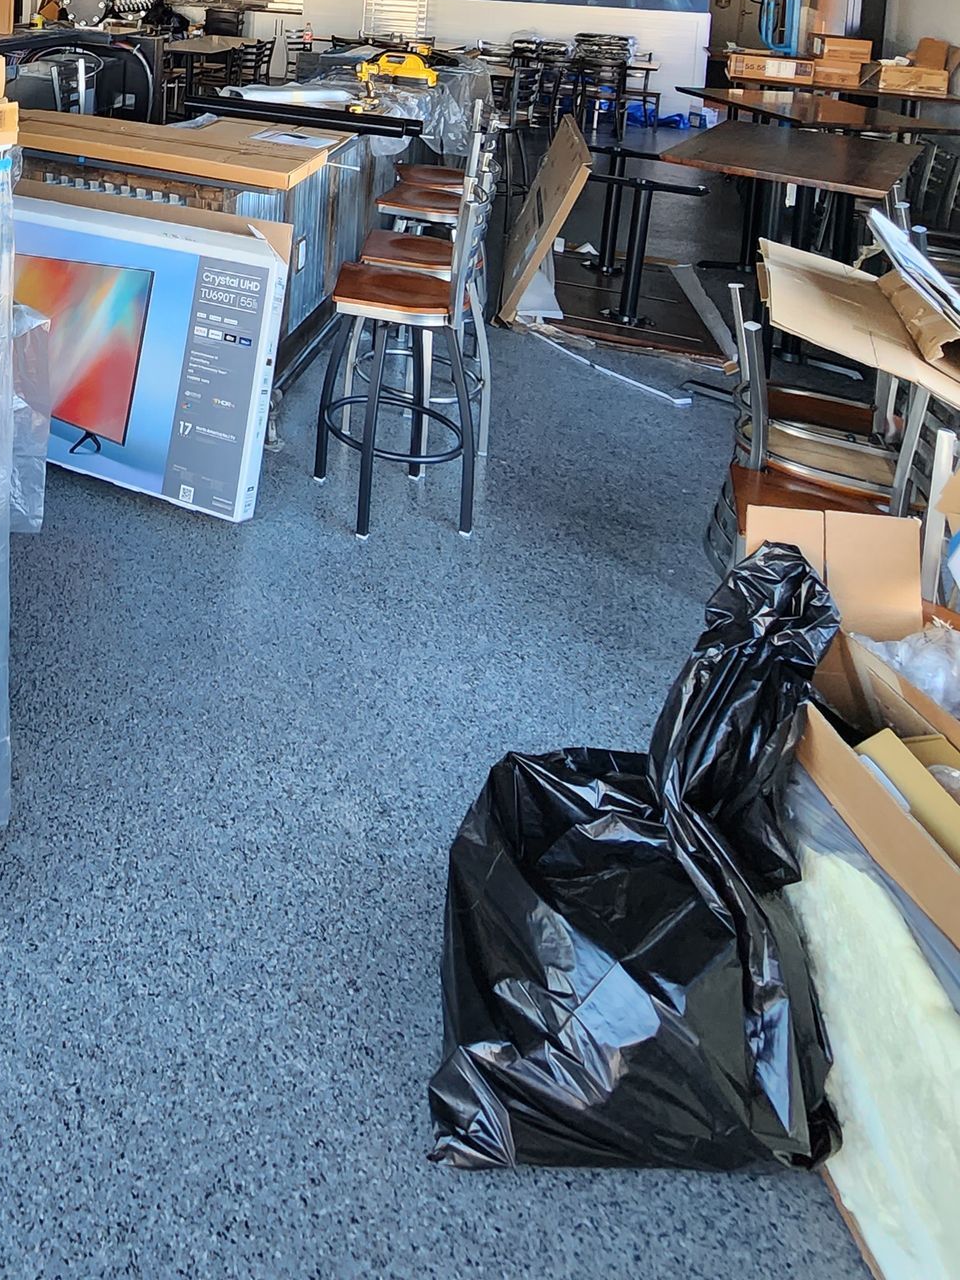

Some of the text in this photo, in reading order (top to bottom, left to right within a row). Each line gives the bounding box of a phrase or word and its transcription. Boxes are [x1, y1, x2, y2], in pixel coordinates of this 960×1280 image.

[202, 272, 260, 291] Crystal UHD
[200, 288, 236, 304] TU690T
[179, 420, 193, 435] 17
